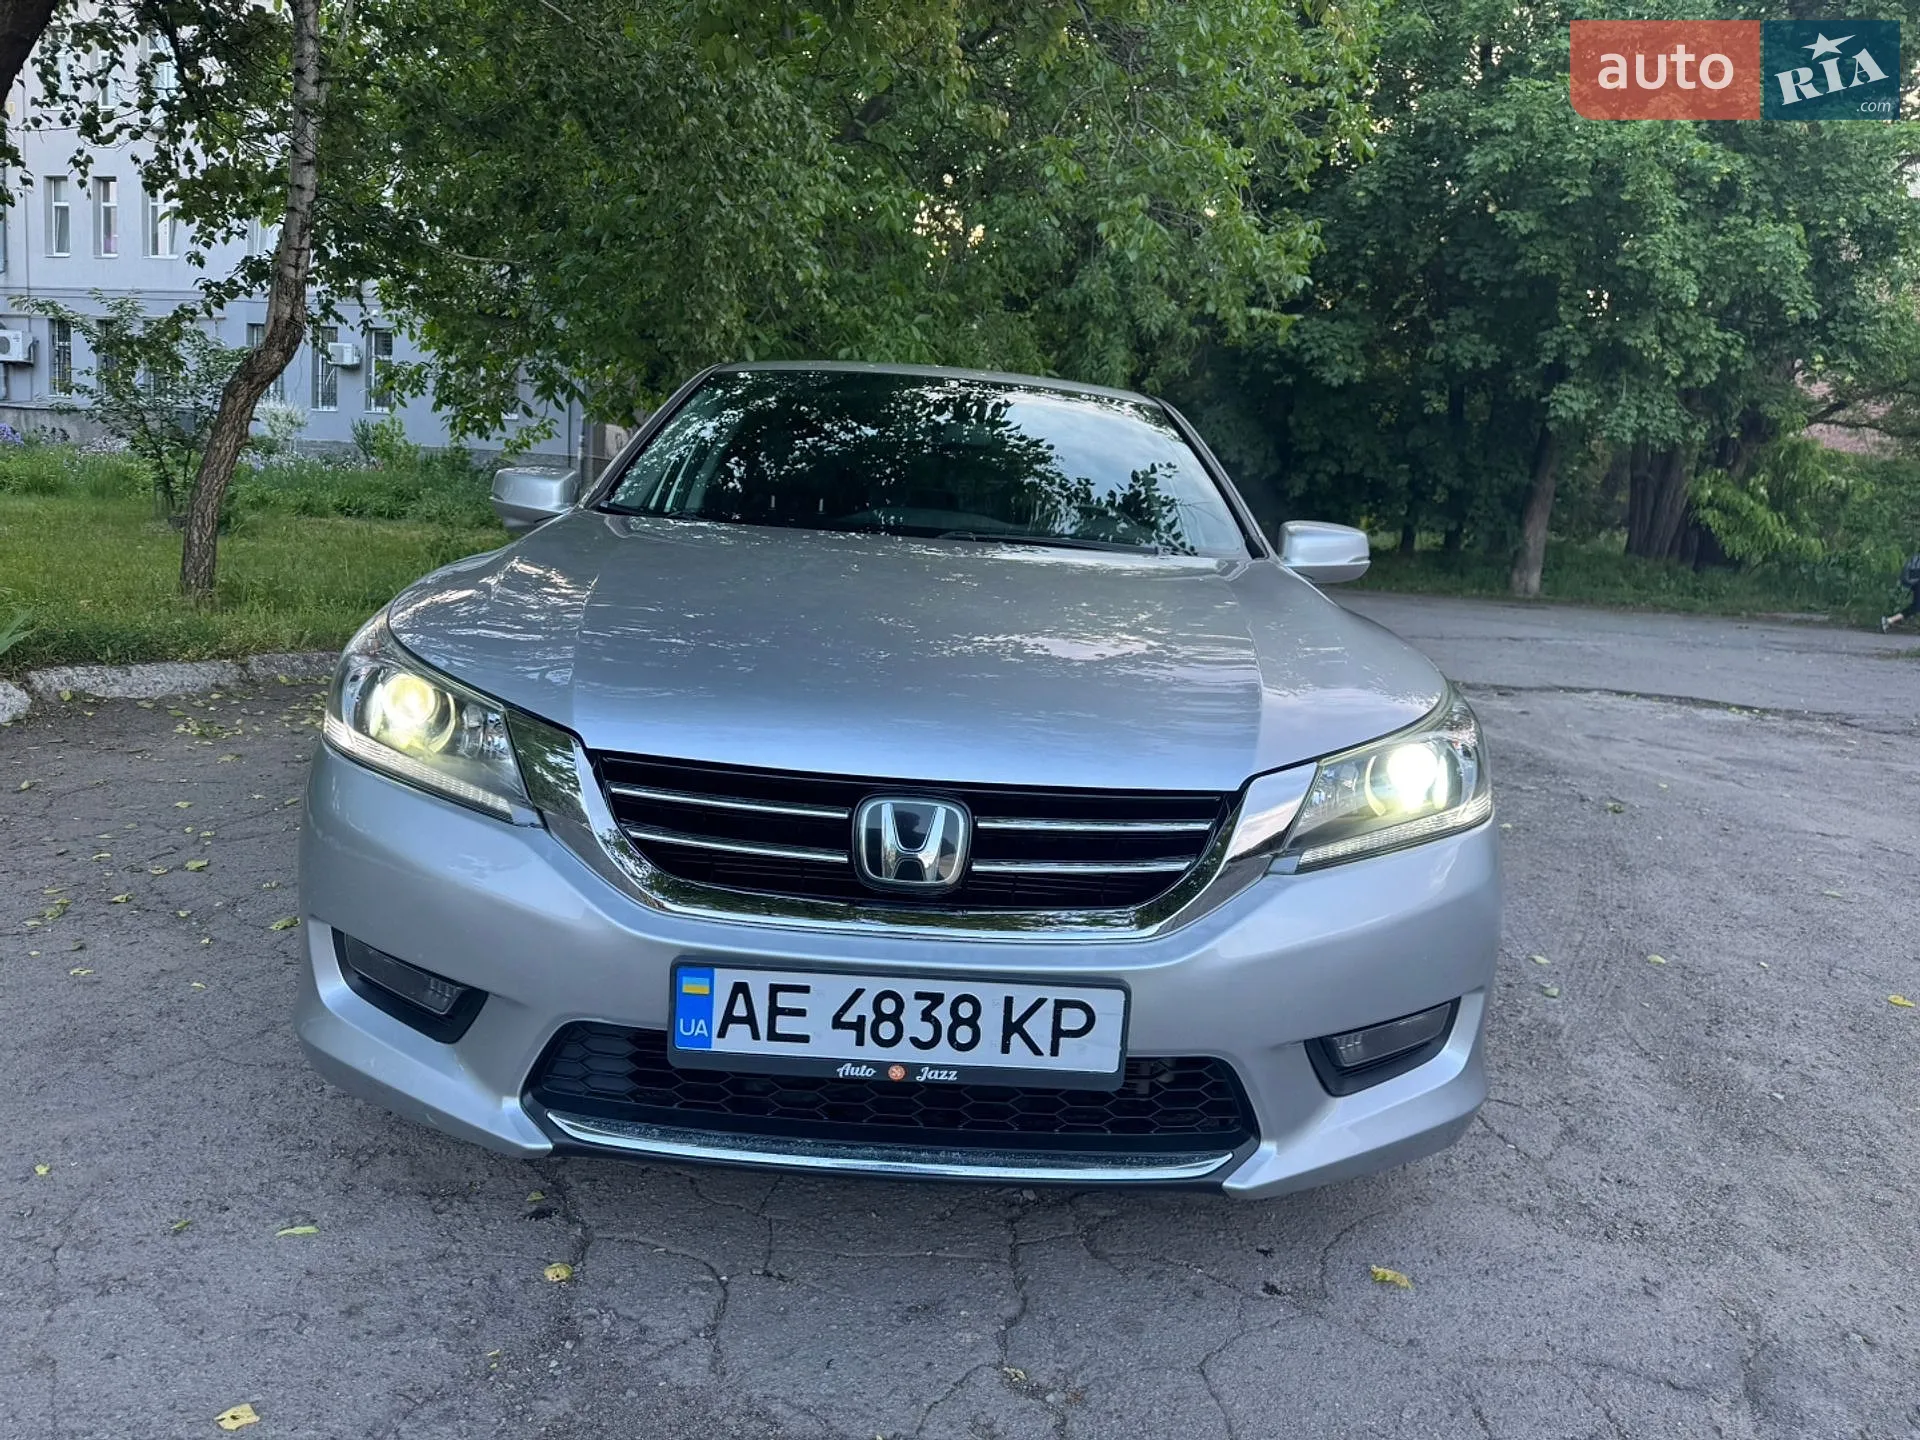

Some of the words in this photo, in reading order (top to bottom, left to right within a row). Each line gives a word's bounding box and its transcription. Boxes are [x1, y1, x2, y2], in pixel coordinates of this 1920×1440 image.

[679, 1018, 709, 1038] UA
[716, 981, 811, 1043] AE
[831, 988, 983, 1054] 4838
[1000, 995, 1097, 1057] KP
[836, 1063, 877, 1078] Auto
[915, 1067, 959, 1082] Jazz
